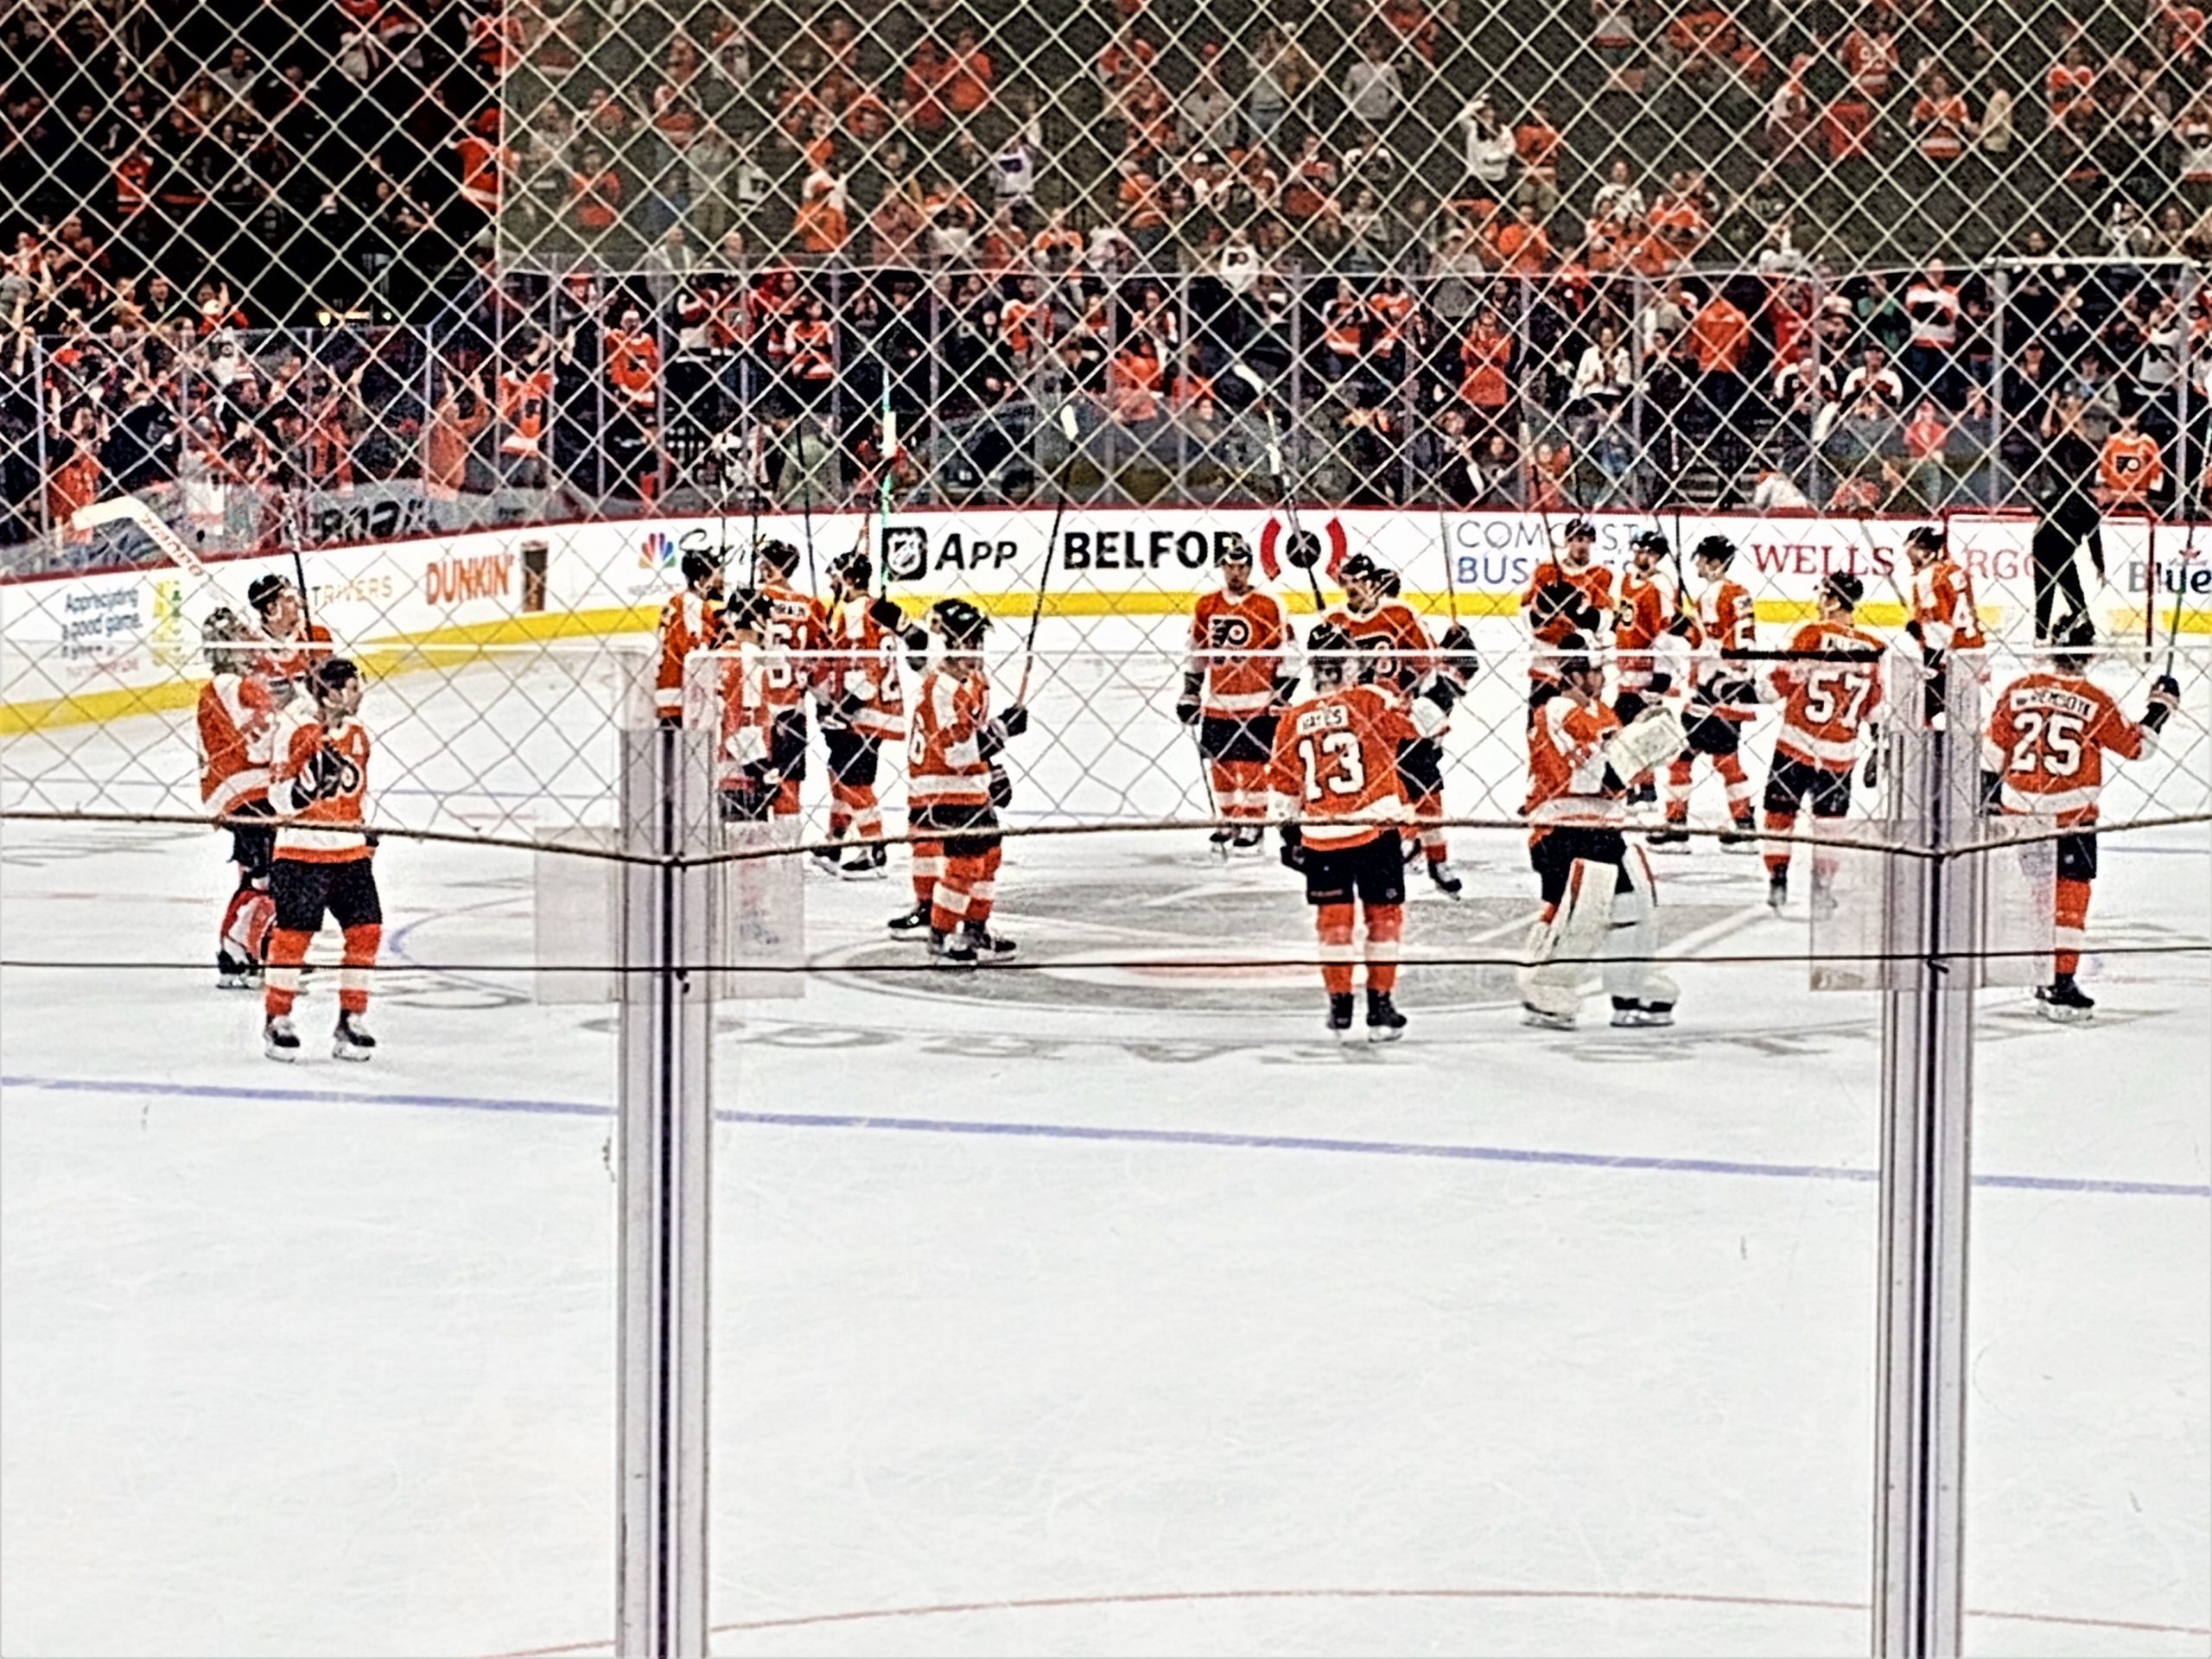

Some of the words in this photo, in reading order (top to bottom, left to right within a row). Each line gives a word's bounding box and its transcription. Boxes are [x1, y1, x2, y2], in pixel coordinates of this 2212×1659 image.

[426, 553, 515, 605] DUNKIN'
[1751, 543, 1894, 576] WELLS
[71, 613, 104, 641] good
[1805, 670, 1872, 728] 57
[1299, 732, 1364, 802] 13
[2012, 712, 2084, 775] 25
